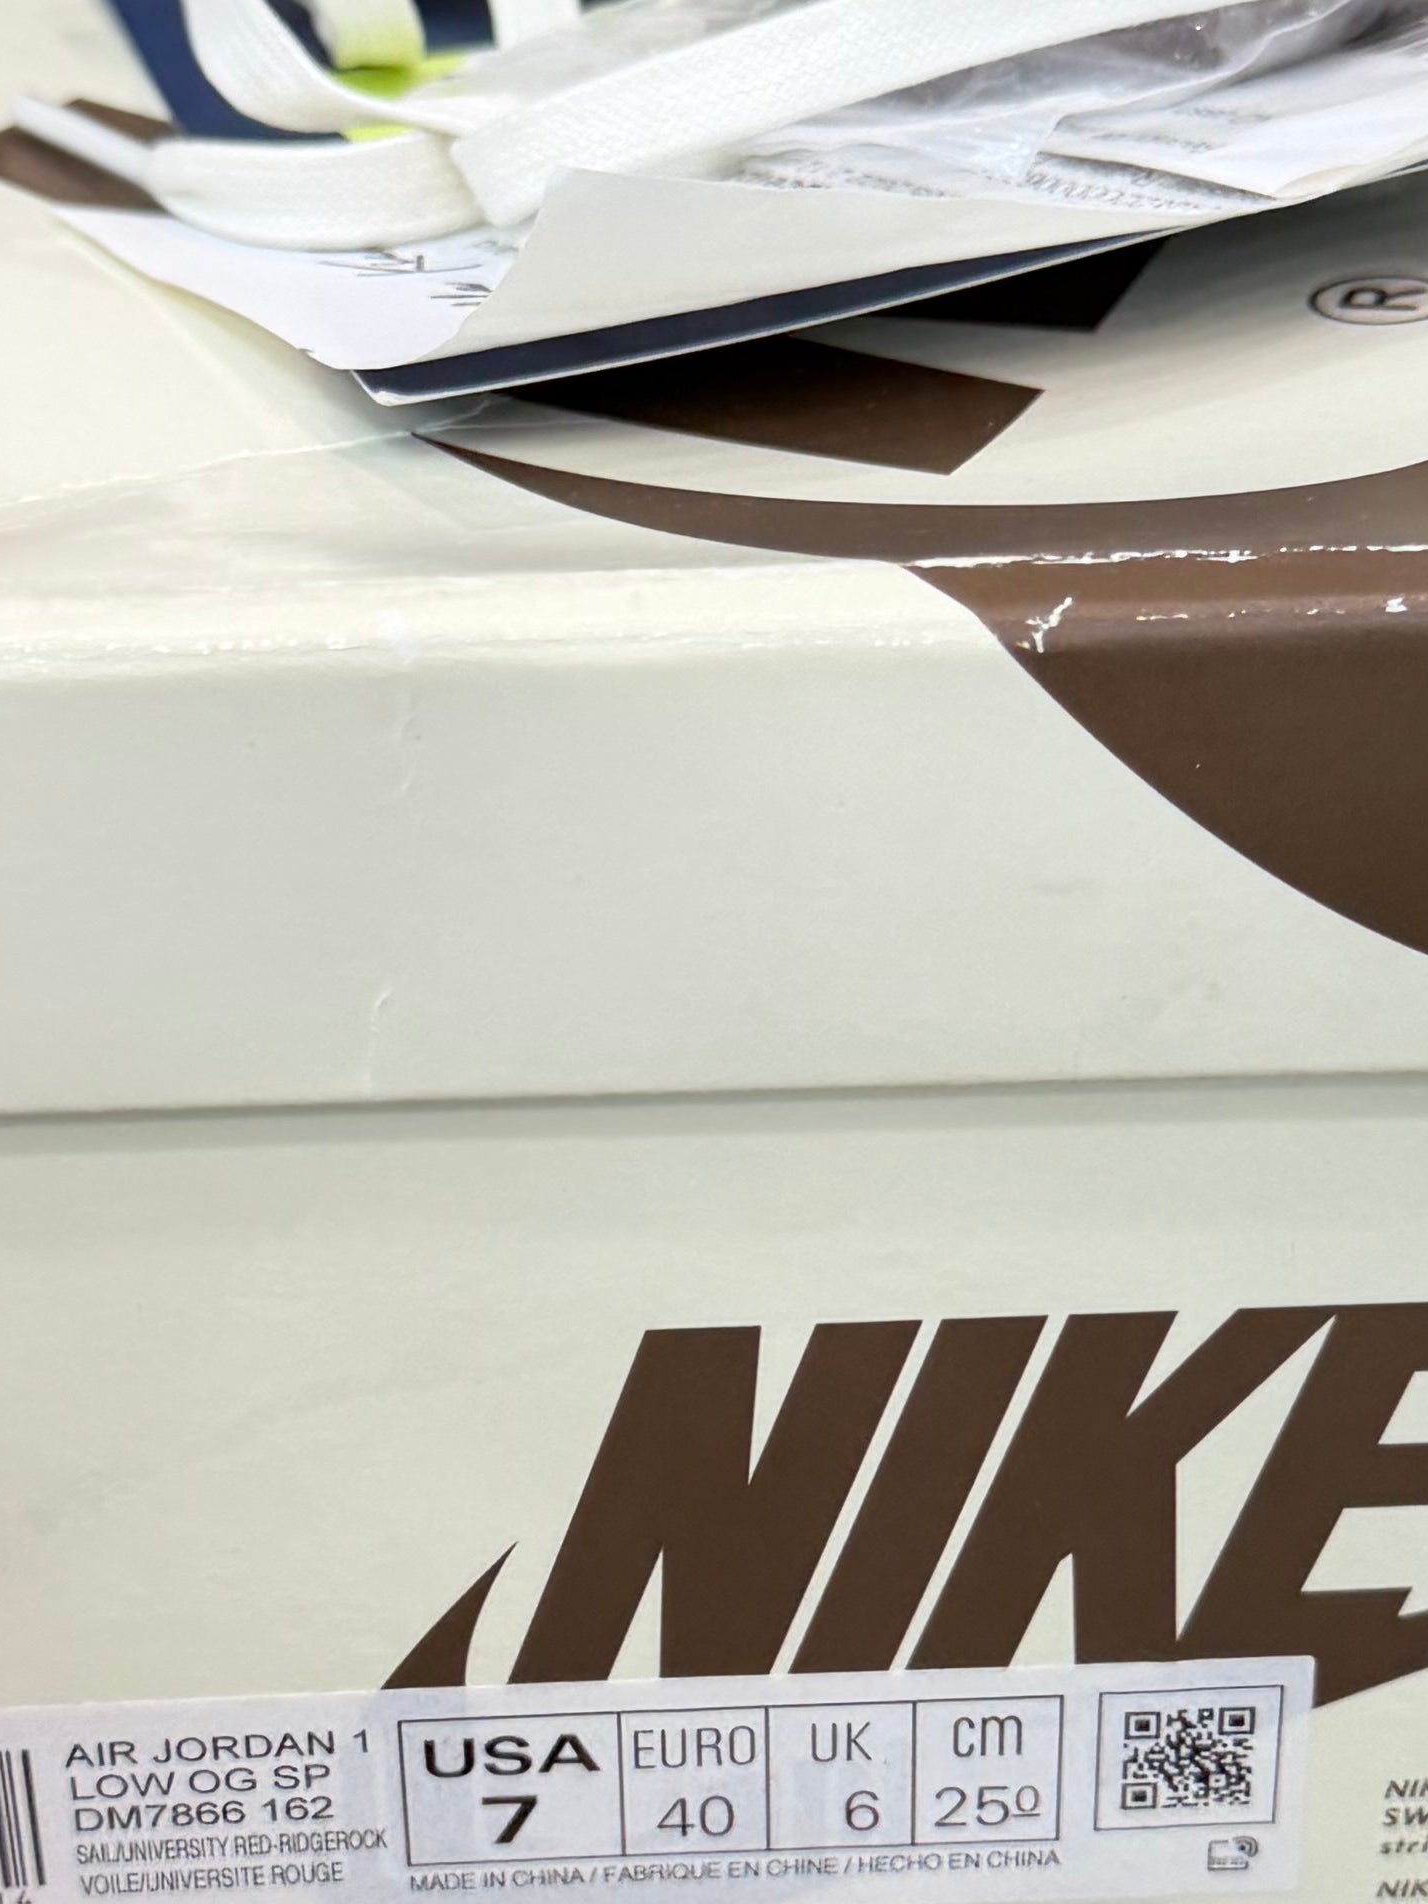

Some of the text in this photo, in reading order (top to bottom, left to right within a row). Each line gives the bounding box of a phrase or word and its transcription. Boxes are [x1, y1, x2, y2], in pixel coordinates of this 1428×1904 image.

[65, 1728, 369, 1768] AIR JORDAN 1
[423, 1733, 601, 1778] USA
[633, 1725, 757, 1770] EURO
[811, 1721, 872, 1762] UK
[953, 1715, 1023, 1758] cm
[69, 1764, 331, 1801] LOW OG SP
[74, 1795, 335, 1831] DM7866 162
[481, 1795, 540, 1845] 7
[656, 1795, 735, 1838] 40
[844, 1790, 880, 1831] 6
[76, 1828, 389, 1865] SAIL/UNIVERSITY RED-RIDGEROCK
[80, 1862, 345, 1895] VOILE/UNIVERSITE ROUGE
[410, 1871, 477, 1891] MADE
[483, 1869, 506, 1888] IN
[512, 1866, 586, 1887] CHINA
[604, 1861, 723, 1883] FABRIQUE
[727, 1860, 759, 1879] EN
[766, 1856, 839, 1878] CHINE
[857, 1852, 942, 1873] HECHO
[947, 1851, 980, 1870] EN
[986, 1849, 1062, 1868] CHINA
